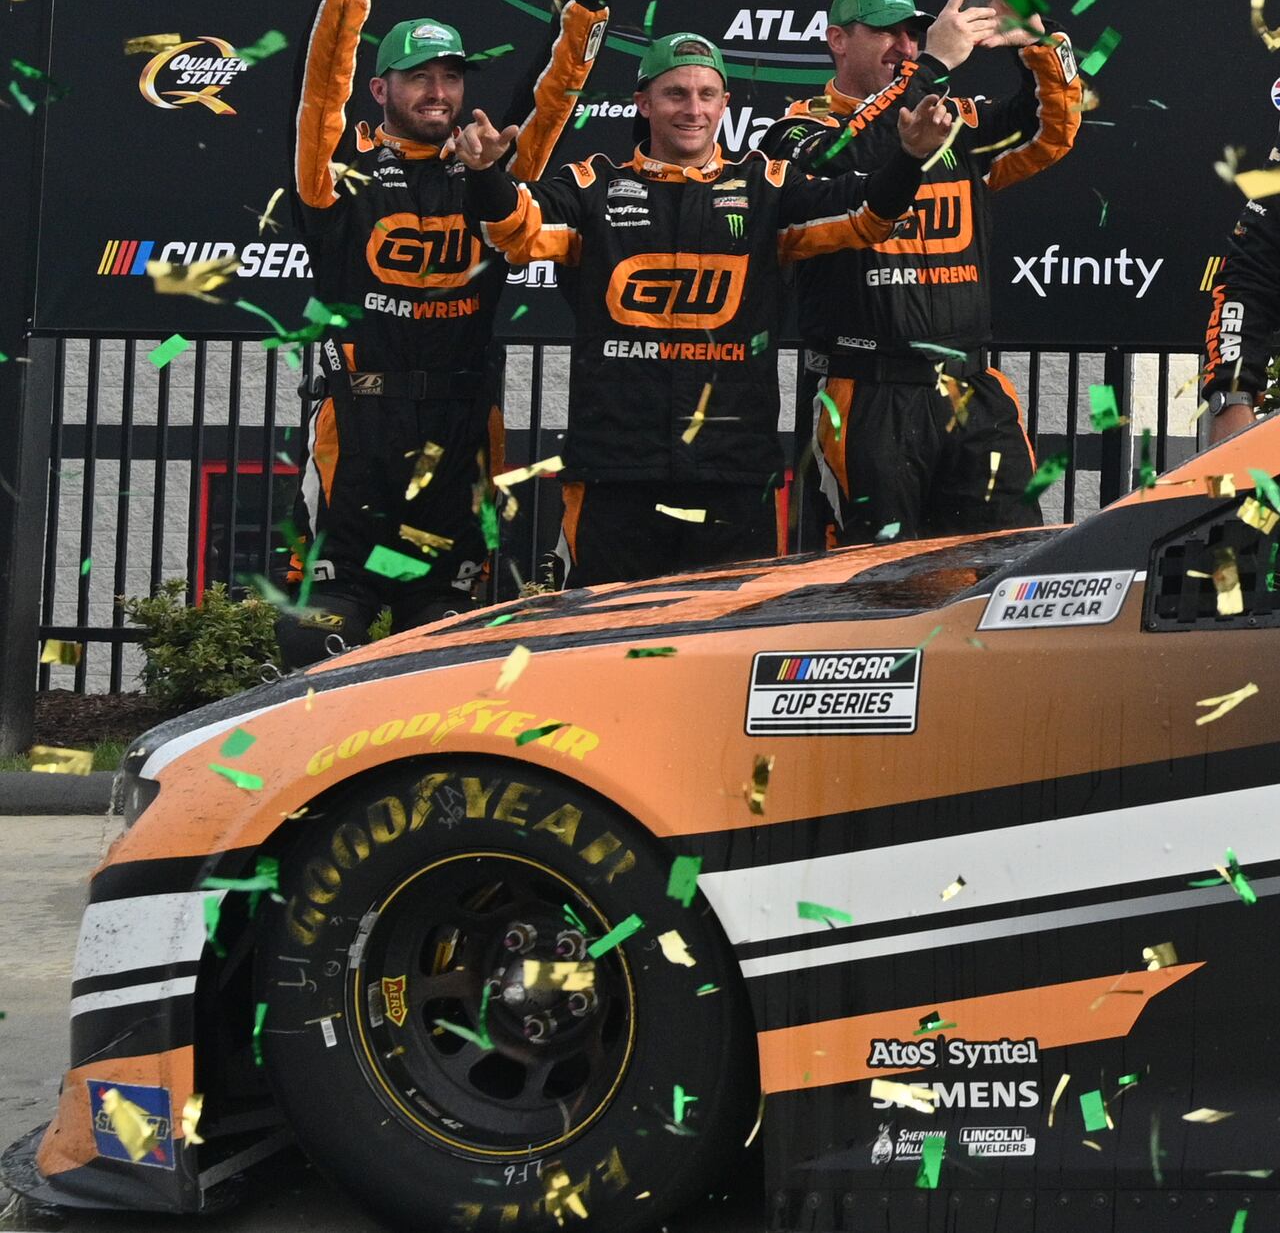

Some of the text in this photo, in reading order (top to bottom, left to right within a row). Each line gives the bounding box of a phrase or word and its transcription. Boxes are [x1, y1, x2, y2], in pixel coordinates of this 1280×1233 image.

[723, 8, 829, 41] ATLA
[168, 53, 248, 74] QUAKER
[176, 68, 238, 86] STATE
[1011, 244, 1164, 298] xfinity
[603, 340, 745, 361] GEARWRENCH
[1031, 577, 1112, 601] NASCAR
[1003, 599, 1102, 621] RACE CAR
[804, 656, 896, 680] NASCAR
[771, 691, 894, 715] CUP SERIES
[305, 699, 600, 776] GOODYEAR
[387, 982, 403, 1019] AERO
[949, 1040, 1038, 1068] Syntel
[962, 1130, 1024, 1142] LINCOLN
[975, 1143, 1027, 1153] WELDERS
